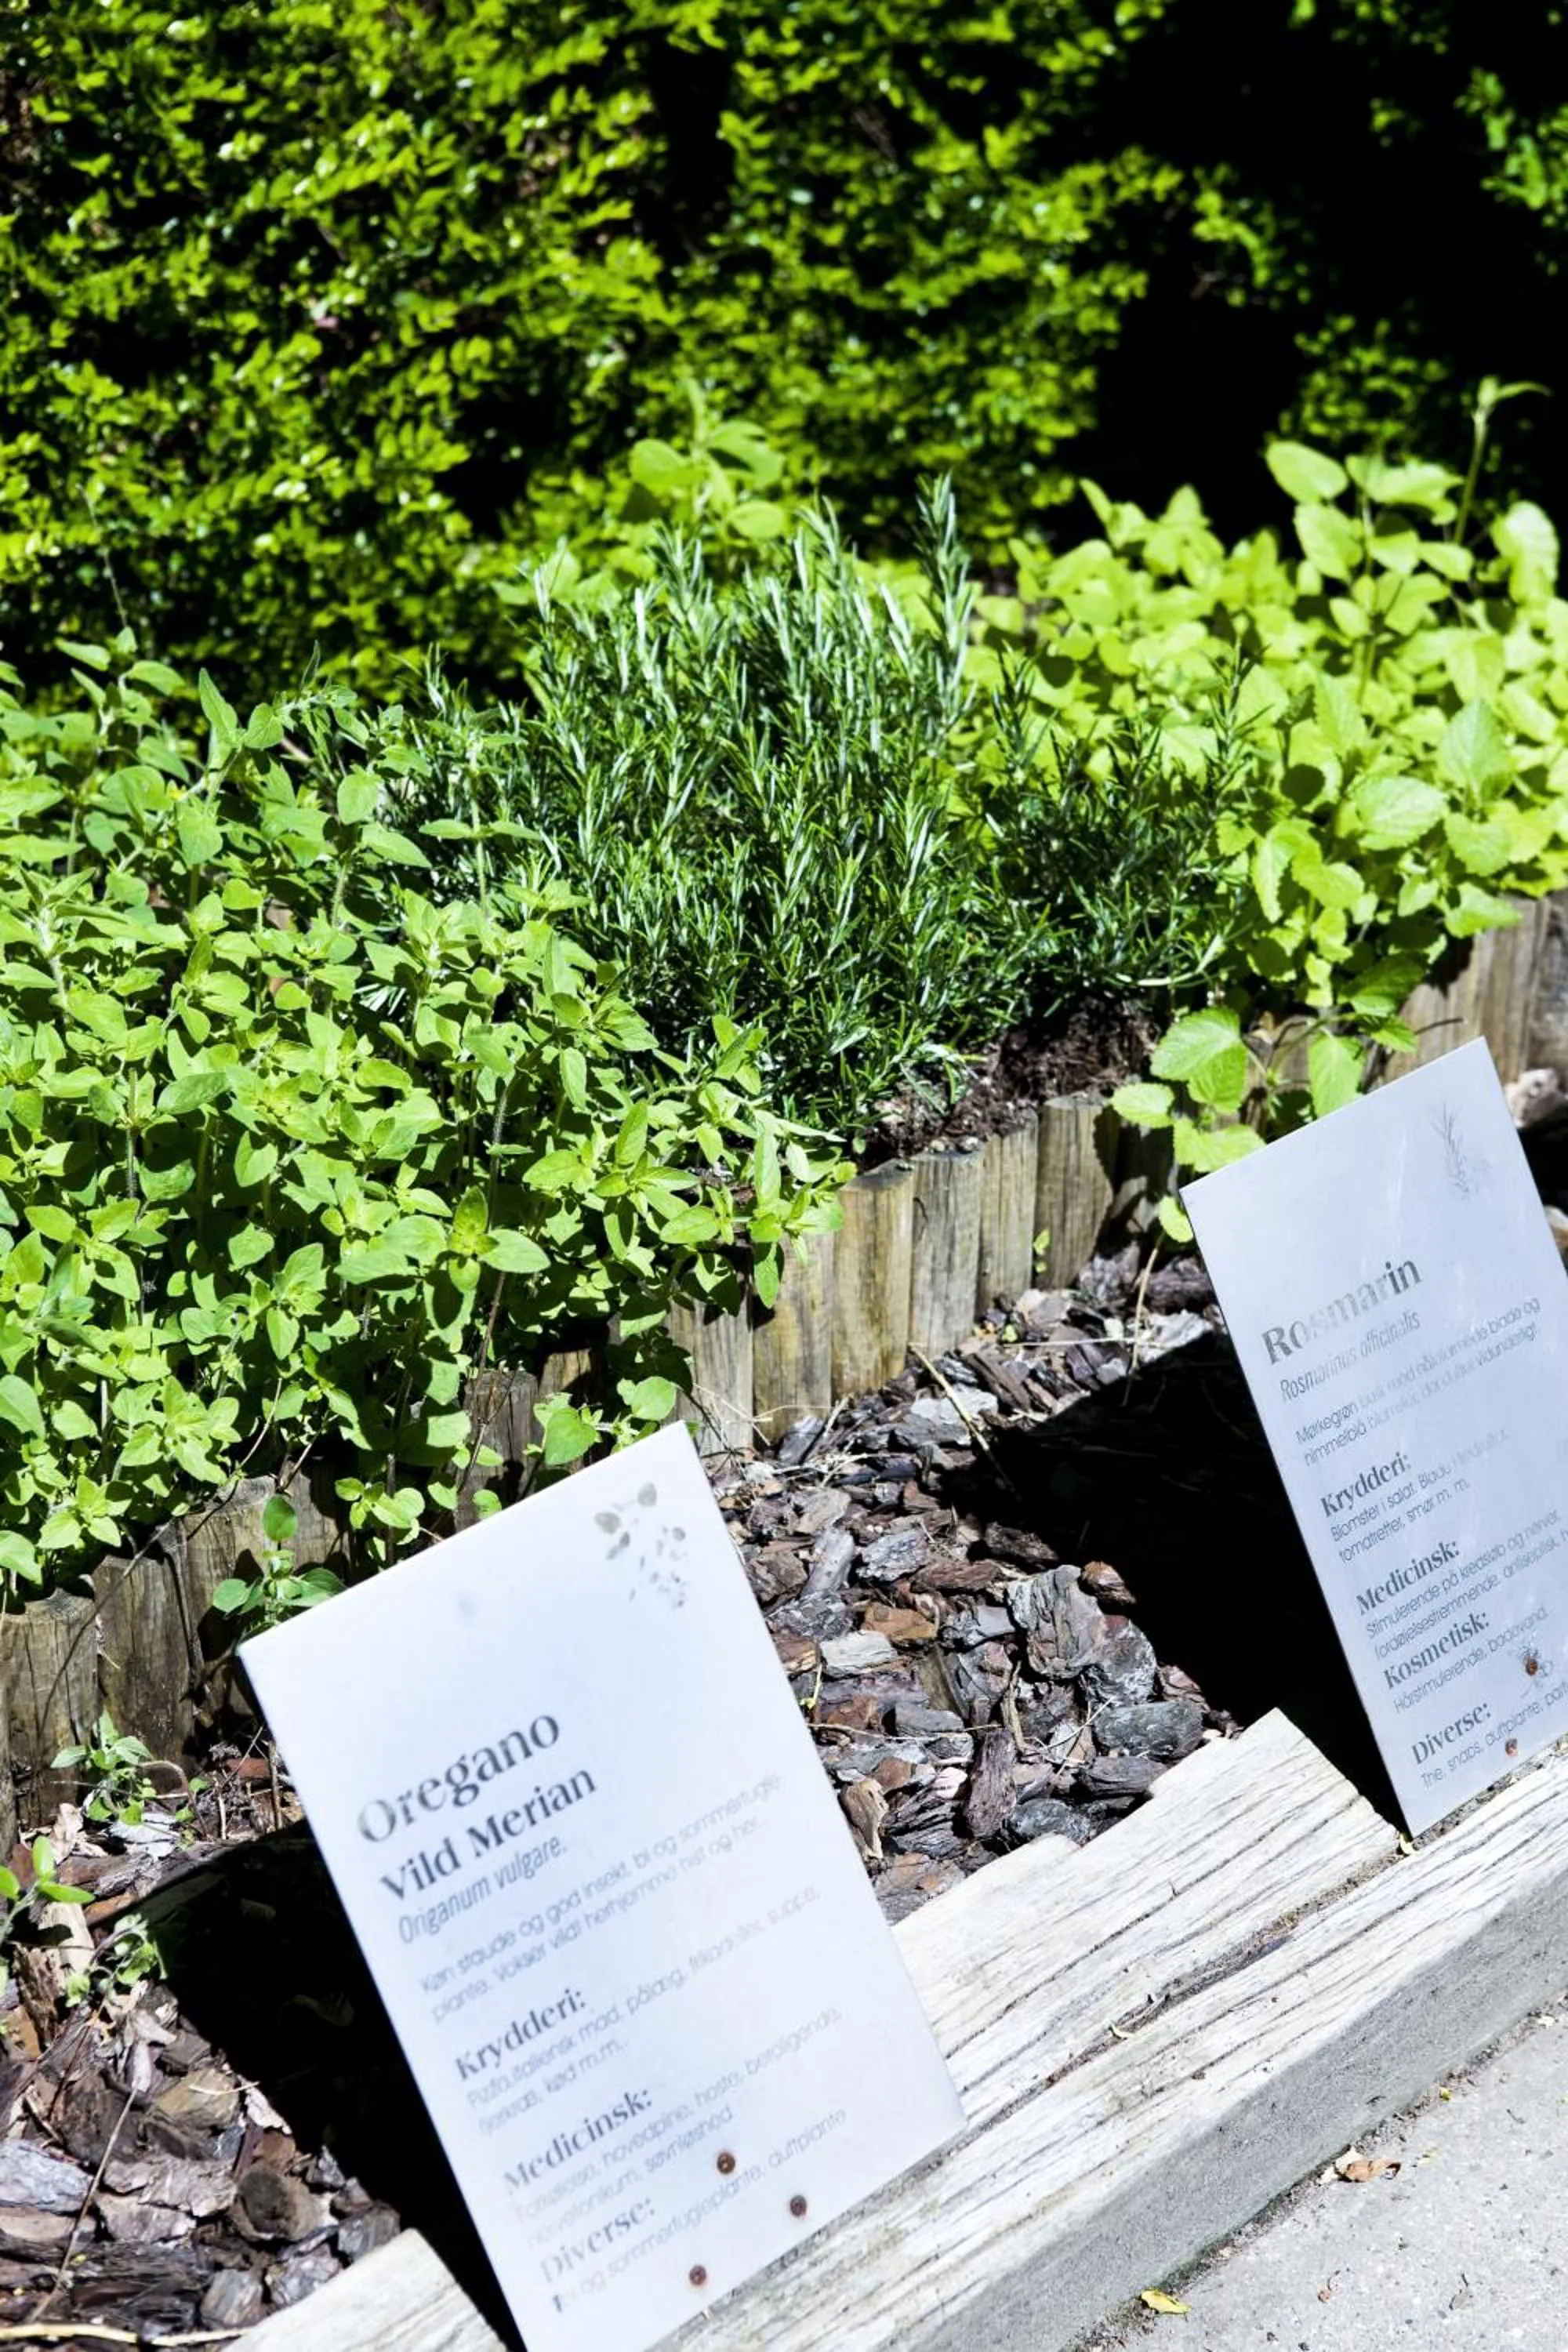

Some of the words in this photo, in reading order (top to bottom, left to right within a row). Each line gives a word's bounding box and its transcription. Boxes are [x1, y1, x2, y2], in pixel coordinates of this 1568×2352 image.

[1261, 1259, 1421, 1364] Rosmarin
[1294, 1400, 1359, 1446] Mørkegrøn
[1522, 1295, 1541, 1316] og
[1319, 1450, 1411, 1519] Krydderi:
[1330, 1503, 1380, 1542] Blomster
[1355, 1538, 1460, 1615] Medicinsk:
[1365, 1583, 1440, 1639] Stimulerende
[1440, 1570, 1460, 1594] på
[1506, 1531, 1525, 1551] og
[1383, 1610, 1490, 1690] Kosmetisk:
[358, 1714, 560, 1843] Oregano
[1410, 1700, 1491, 1765] Diverse:
[379, 1837, 461, 1900] Vild
[466, 1769, 595, 1857] Merian
[706, 1833, 733, 1857] og
[397, 1875, 491, 1944] Origanum
[493, 1835, 567, 1889] vulgare.
[517, 1912, 546, 1940] og
[544, 1889, 583, 1926] god
[652, 1834, 679, 1860] og
[455, 1987, 585, 2081] Krydderi:
[503, 2086, 652, 2189] Medicinsk:
[539, 2195, 655, 2283] Diverse:
